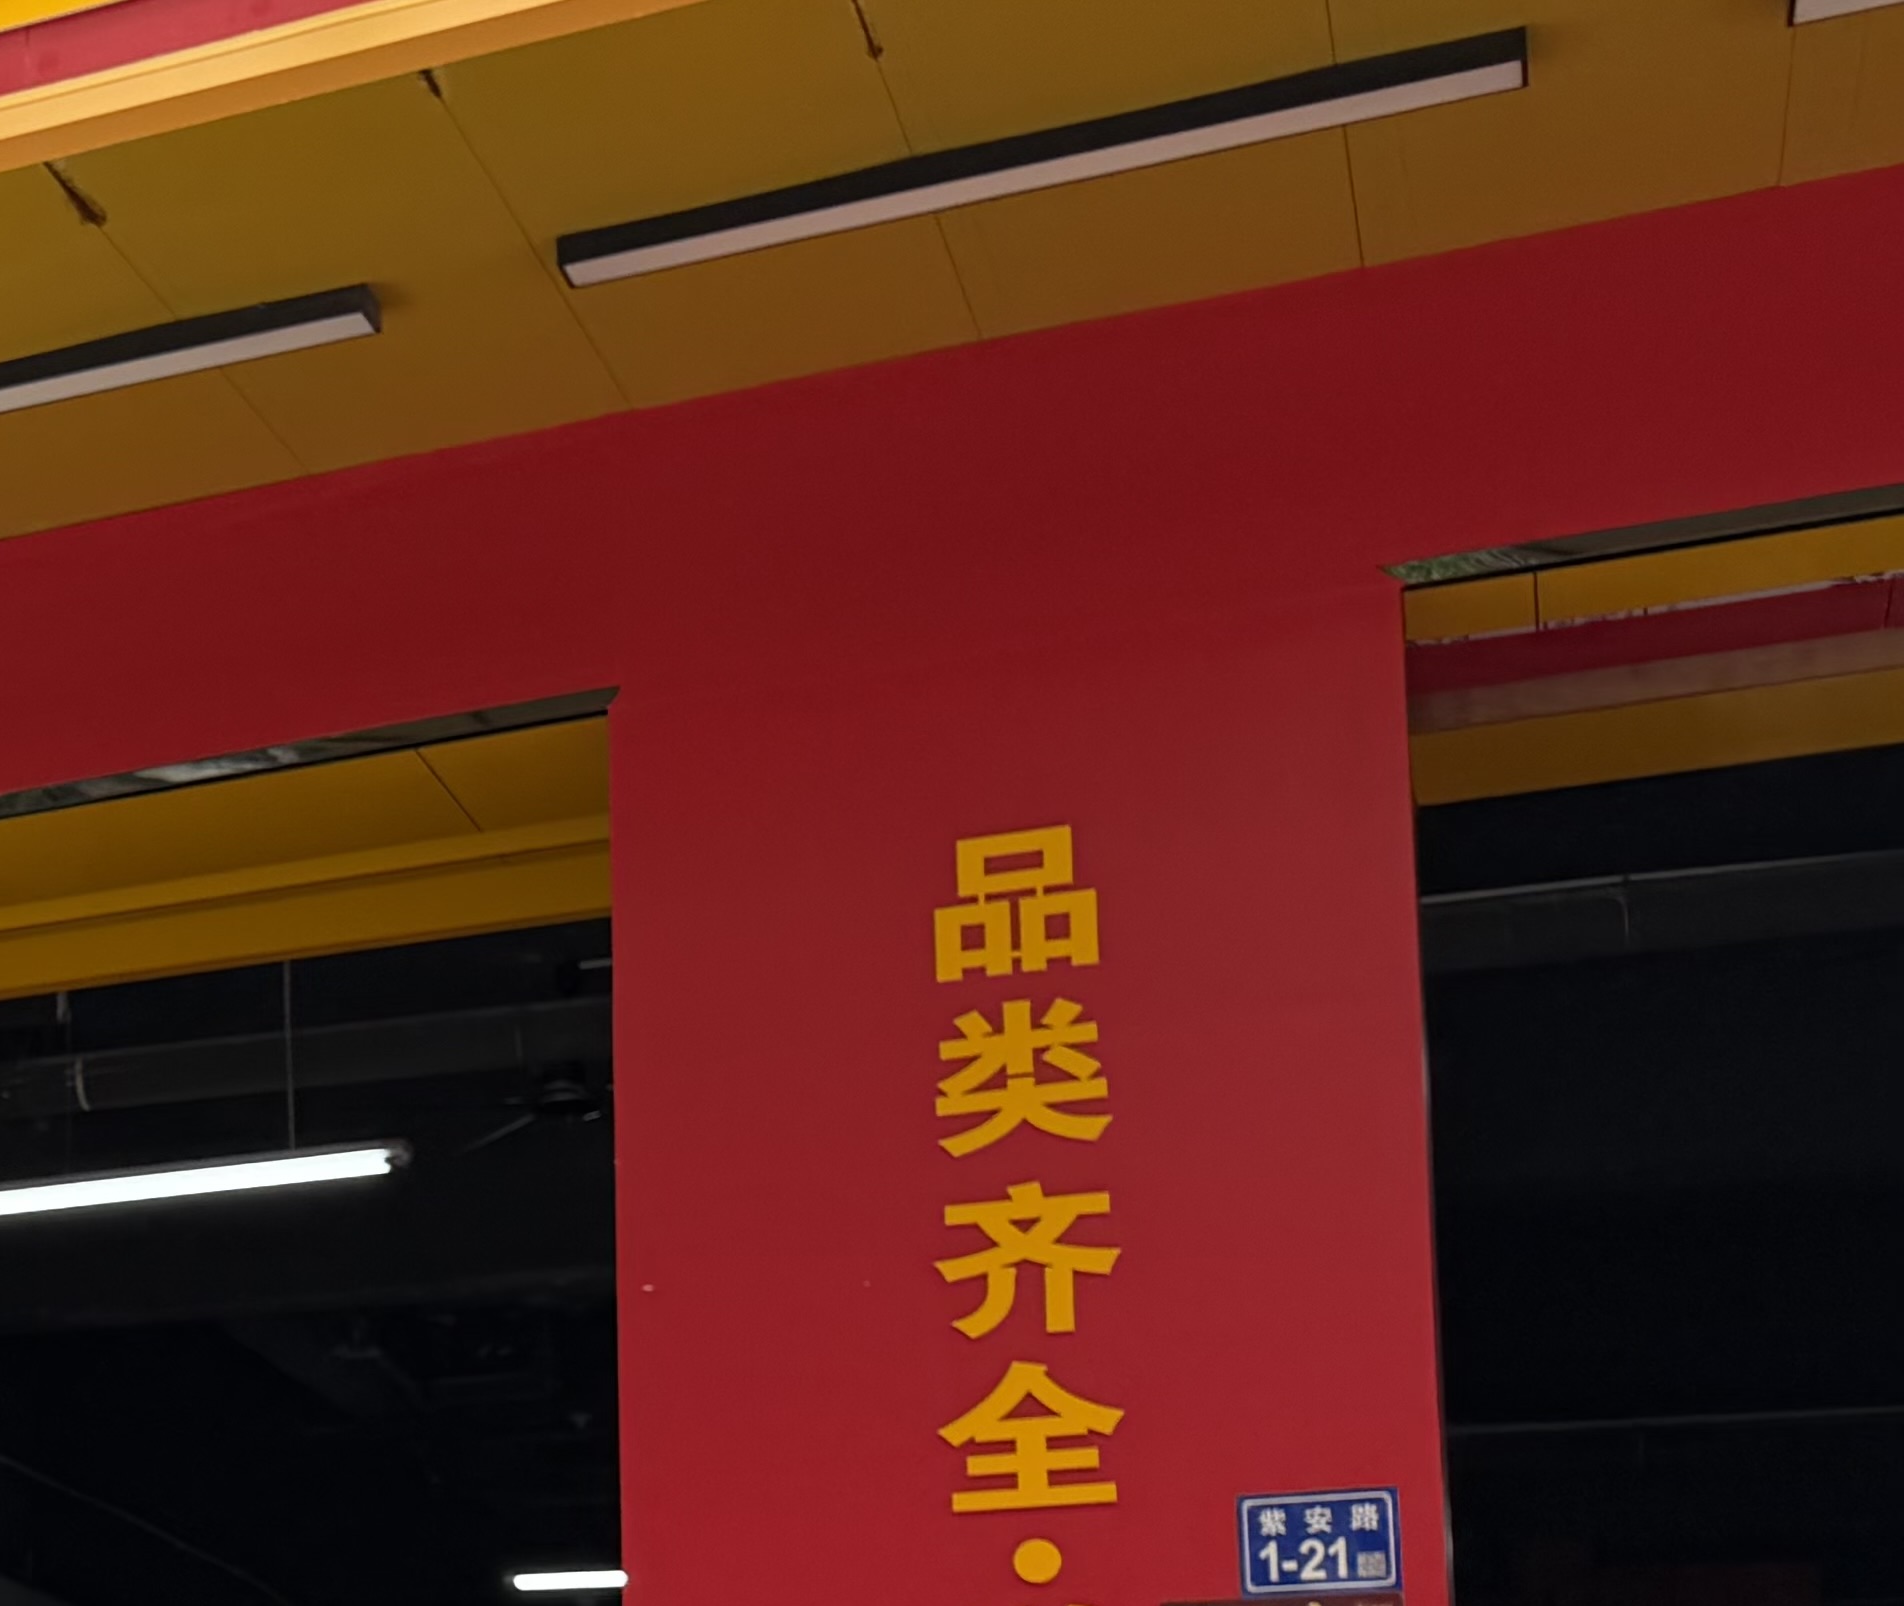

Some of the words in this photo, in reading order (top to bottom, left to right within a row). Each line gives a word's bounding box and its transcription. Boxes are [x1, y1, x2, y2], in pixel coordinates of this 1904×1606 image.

[1258, 1502, 1380, 1536] 紫安路
[1259, 1539, 1353, 1584] 1-21
